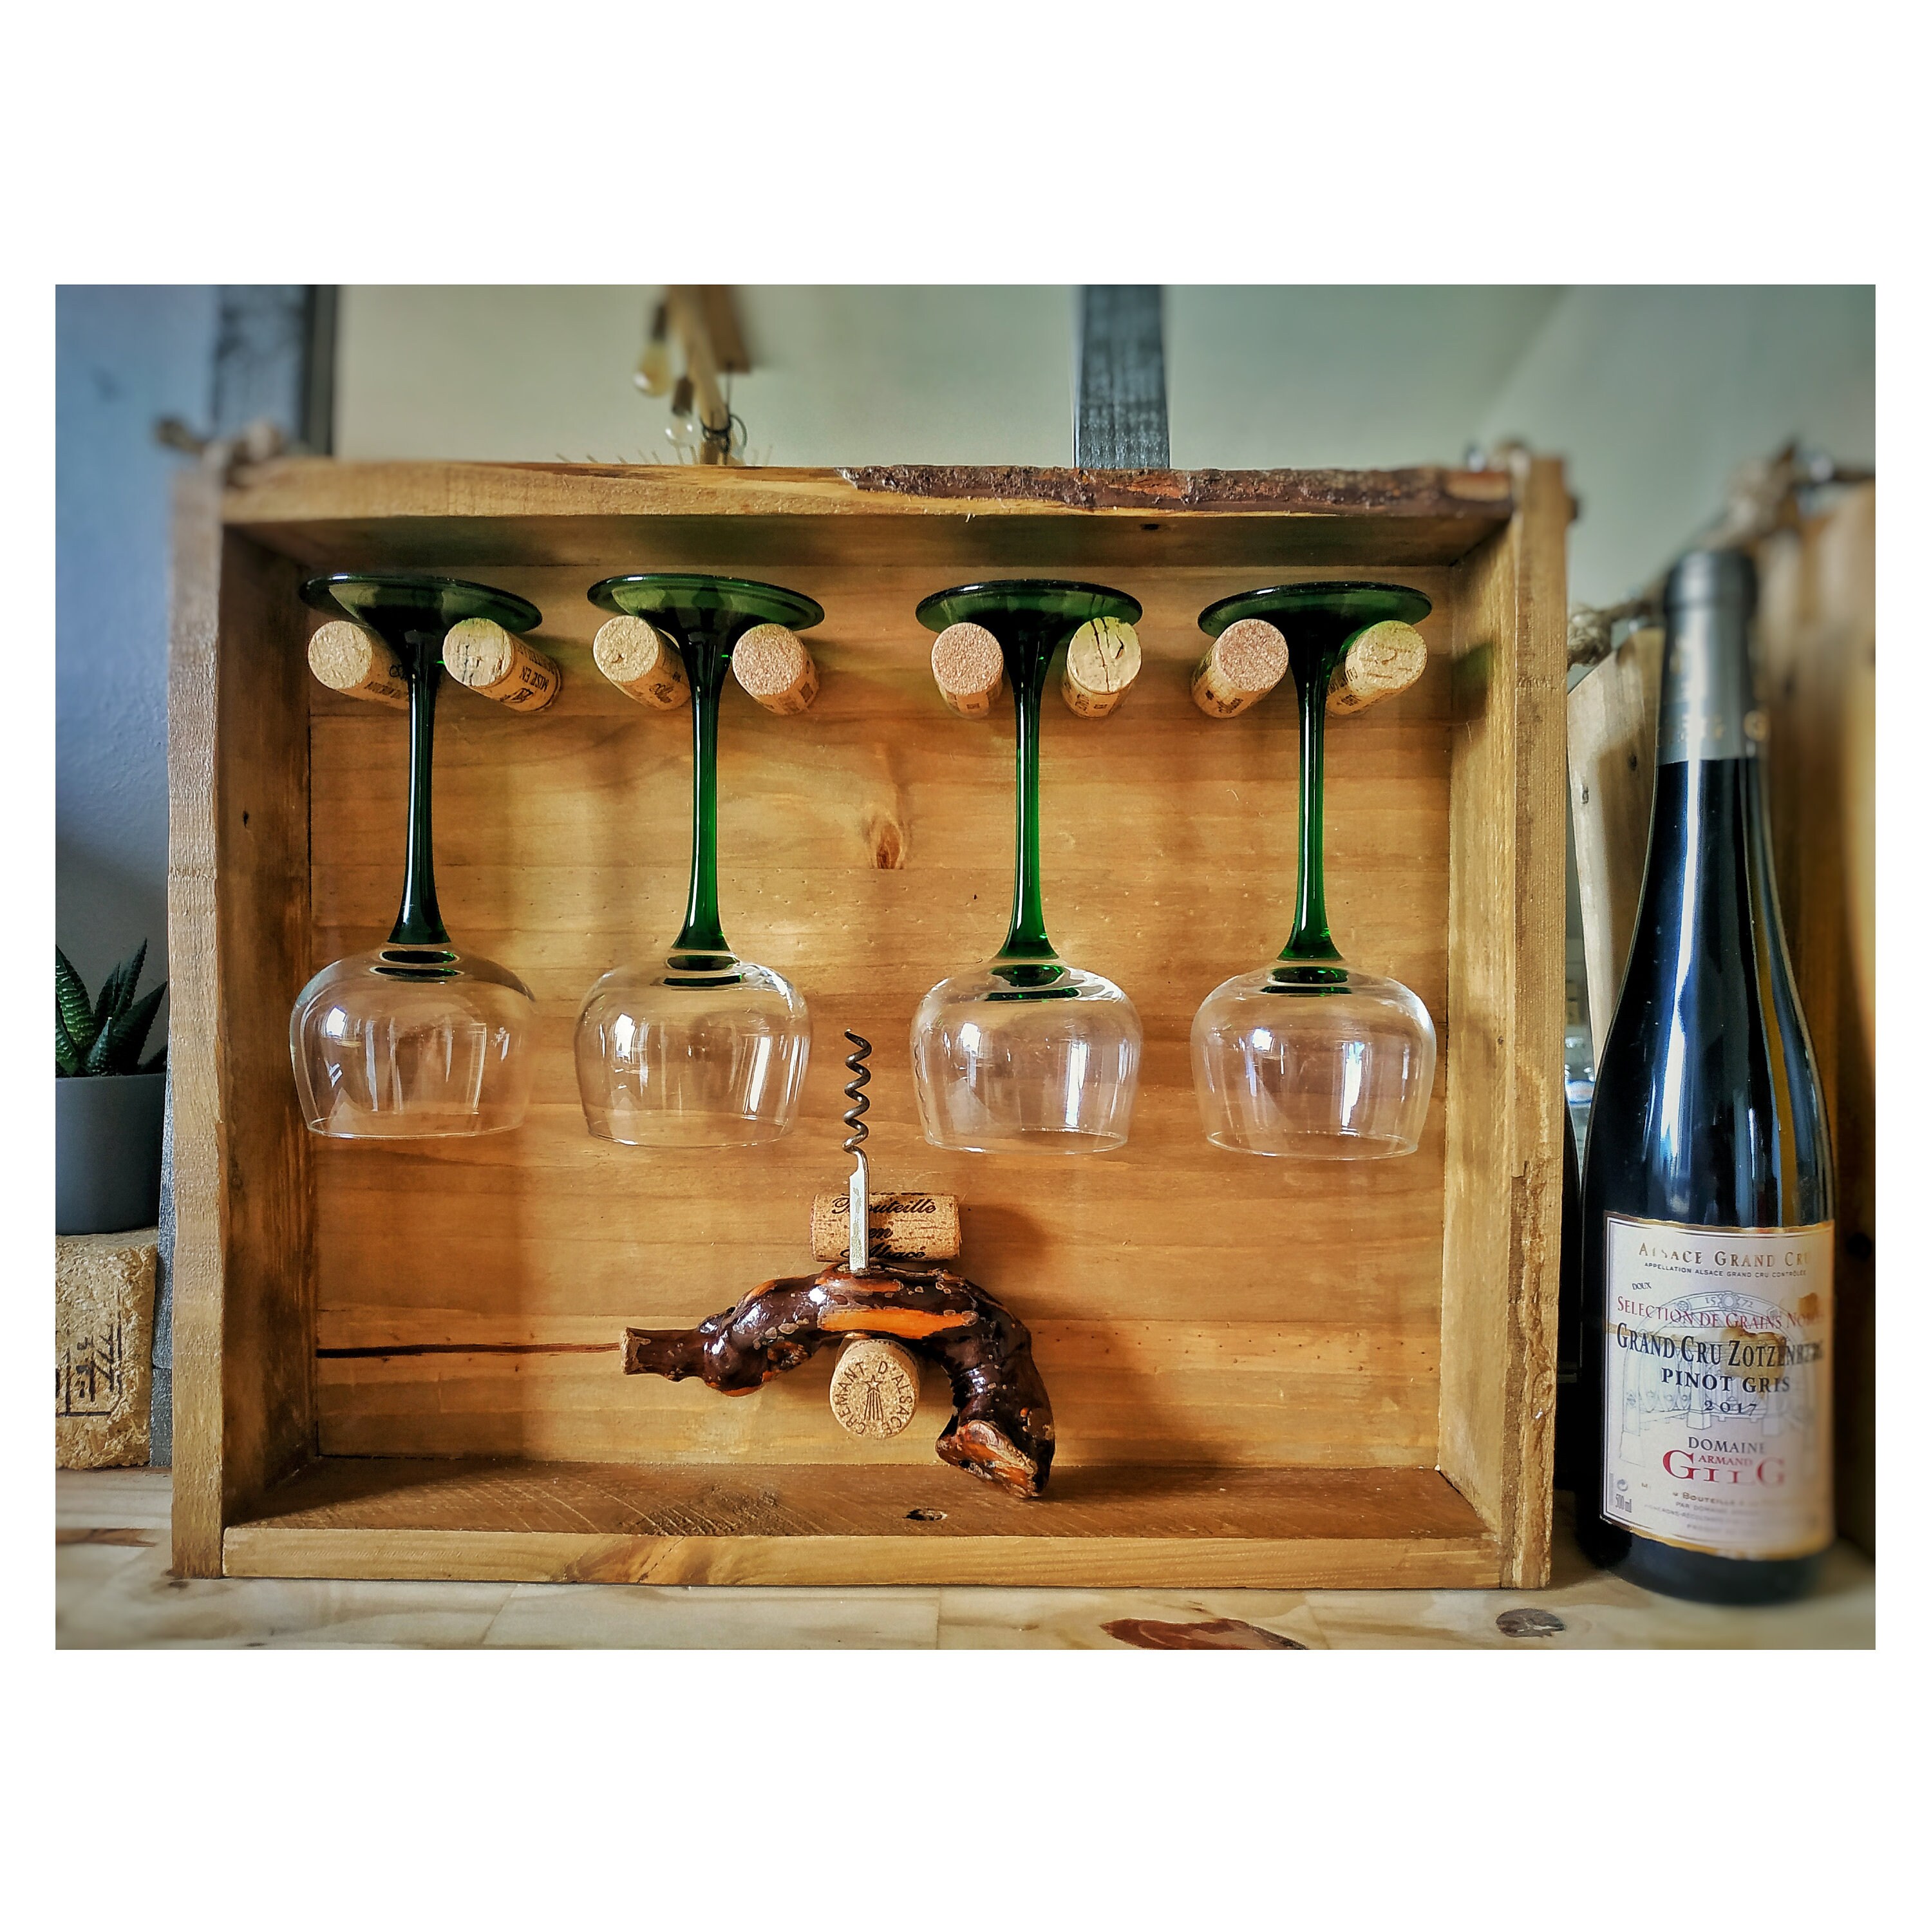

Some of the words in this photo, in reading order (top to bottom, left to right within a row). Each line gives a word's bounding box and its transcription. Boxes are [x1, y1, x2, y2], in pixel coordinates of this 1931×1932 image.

[1639, 1242, 1703, 1265] ALSACE
[1714, 1250, 1775, 1267] GRAND
[1784, 1251, 1811, 1267] CRU
[1644, 1262, 1692, 1274] APPELLATION
[1632, 1282, 1653, 1291] DOUX
[1705, 1296, 1717, 1307] 15
[1741, 1299, 1753, 1309] 72
[1617, 1295, 1694, 1325] SELECTION
[1700, 1312, 1720, 1327] DE
[1725, 1312, 1782, 1330] GRAINS
[1617, 1322, 1676, 1359] GRAND
[1681, 1335, 1723, 1365] CRU
[1661, 1367, 1732, 1392] PINOT
[1742, 1376, 1791, 1394] GRIS
[834, 1361, 866, 1435] CREMANT
[878, 1360, 913, 1436] D'ALSACE
[1704, 1400, 1758, 1417] 2017
[1688, 1436, 1766, 1455] DOMAINE
[1698, 1455, 1753, 1467] ARMAND
